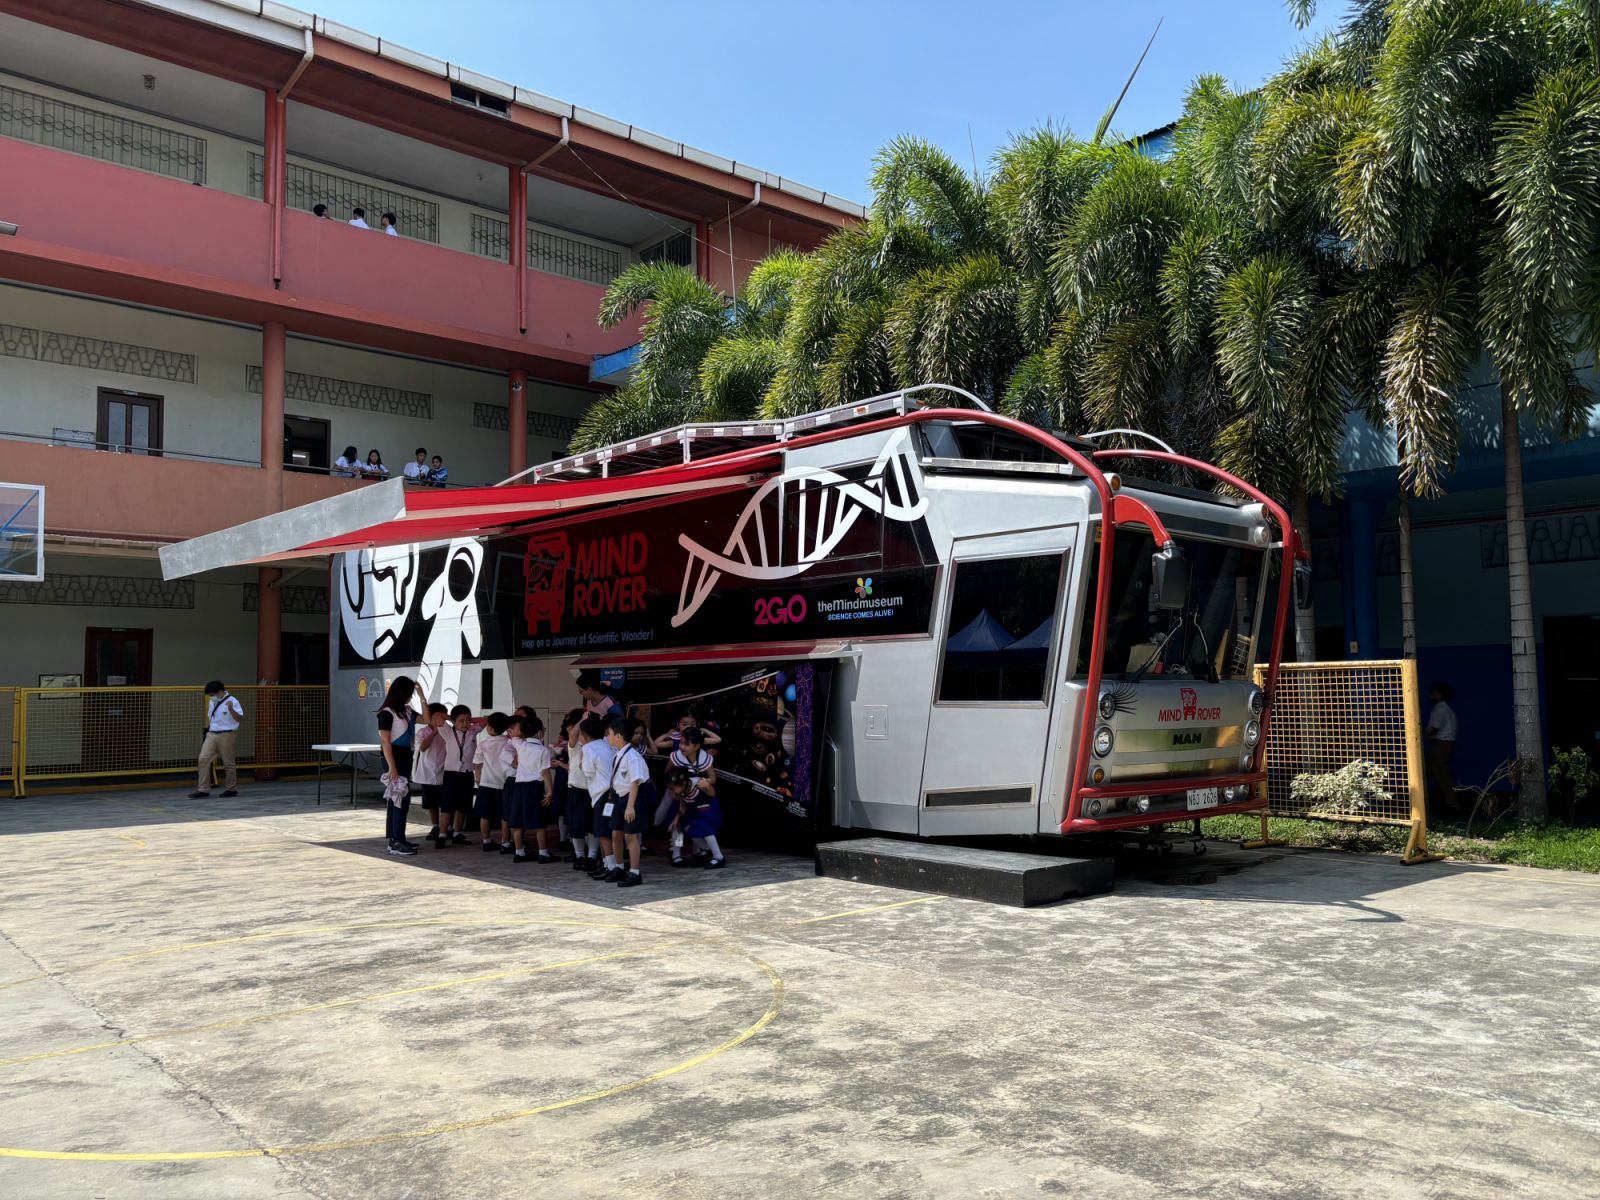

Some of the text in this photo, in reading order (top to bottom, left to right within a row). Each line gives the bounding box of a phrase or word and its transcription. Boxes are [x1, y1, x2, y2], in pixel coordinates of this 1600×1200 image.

[574, 532, 648, 580] MIND
[573, 575, 647, 618] ROVER
[754, 594, 807, 625] 2GO
[827, 608, 894, 621] SCIENCE COMES ALIVE!
[522, 628, 654, 650] Hop on a Journey of Scientific Wonder!
[1158, 707, 1221, 722] MIND ROVER
[1172, 732, 1201, 746] MAN
[1202, 791, 1217, 804] 2626
